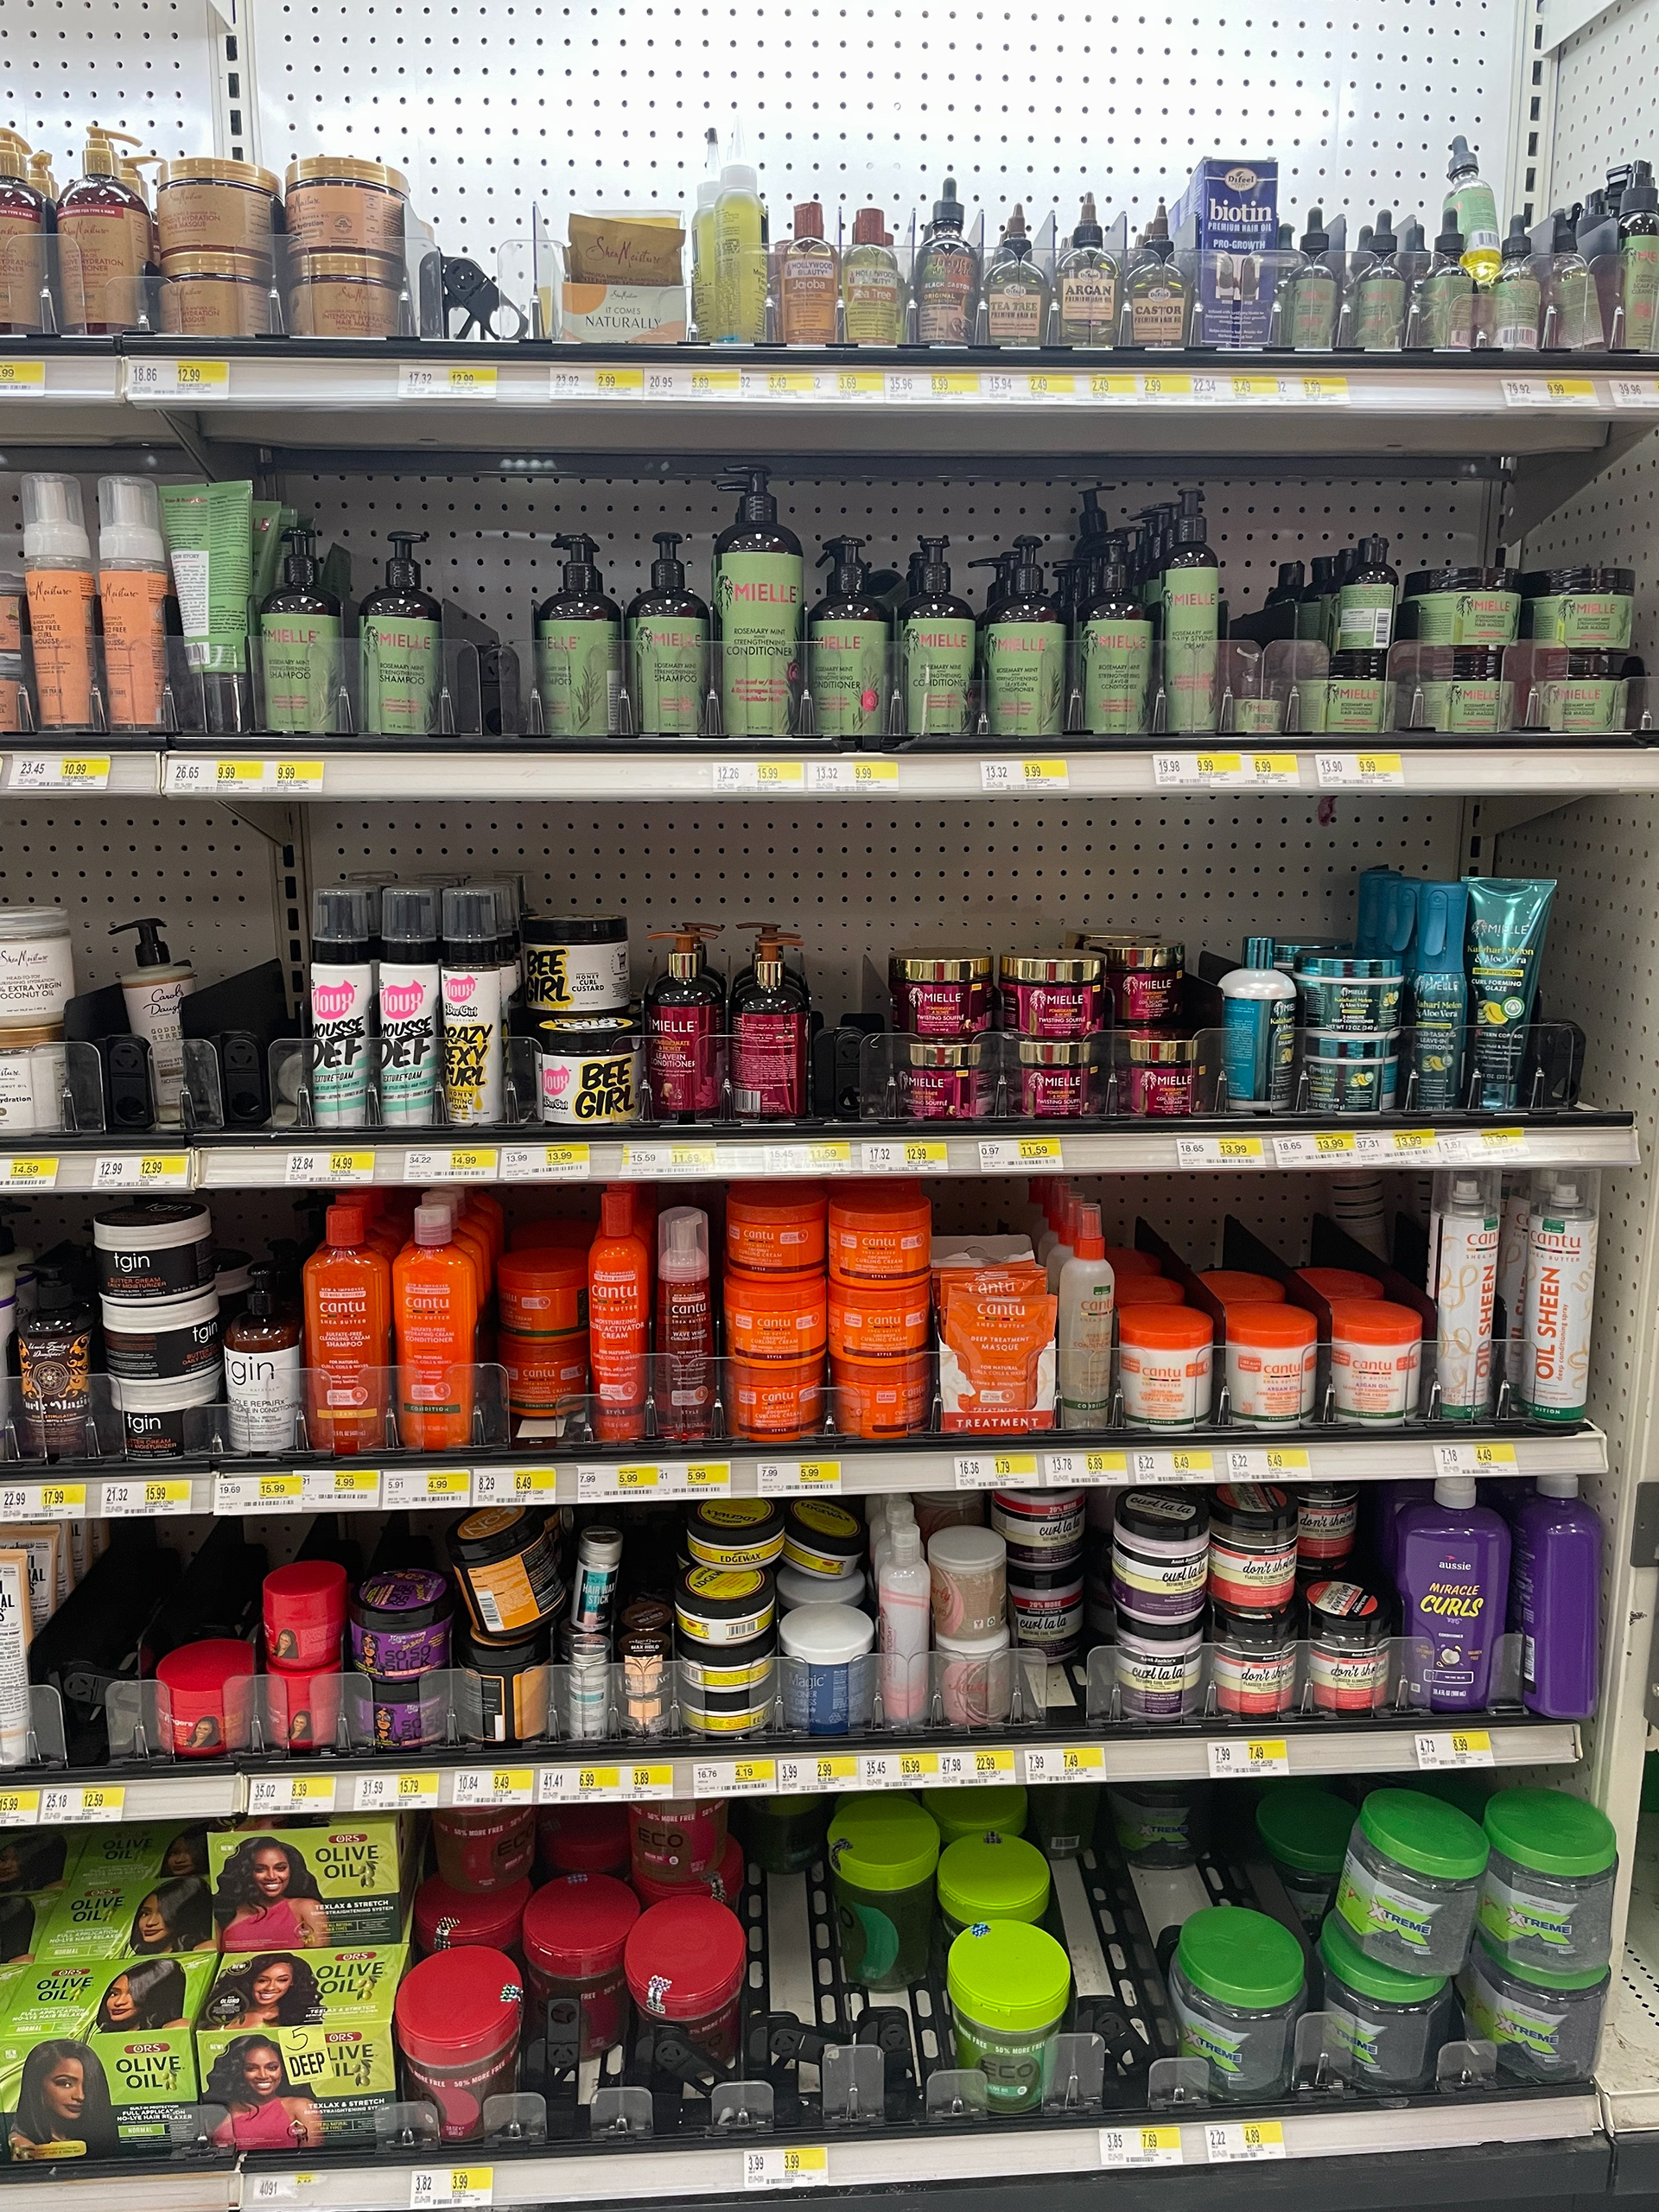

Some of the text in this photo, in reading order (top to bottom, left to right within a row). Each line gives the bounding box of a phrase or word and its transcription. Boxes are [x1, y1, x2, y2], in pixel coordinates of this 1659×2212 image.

[1228, 175, 1255, 185] Difeel
[1209, 200, 1273, 223] biotin
[1208, 222, 1273, 233] PREMIUM HAIR OIL
[1213, 239, 1267, 250] PRO-GROWTH
[1065, 284, 1112, 297] ARGAN
[991, 302, 1010, 313] TEA
[586, 316, 663, 330] NATURALLY
[133, 368, 158, 383] 18.86
[178, 369, 200, 383] 12.99
[556, 376, 580, 387] 23.92
[598, 376, 616, 388] 2.99
[650, 377, 674, 389] 20.95
[890, 378, 913, 391] 35.96
[931, 378, 950, 391] 8.99
[989, 378, 1013, 391] 15.94
[1507, 383, 1532, 396] 79.92
[734, 583, 797, 604] MIELLE
[1174, 593, 1216, 607] MIELLE
[1472, 600, 1511, 613] MIELLE
[270, 630, 315, 644] MIELLE
[379, 634, 431, 651] MIELLE
[920, 634, 968, 648] MIELLE
[726, 645, 793, 658] CONDITIONER
[270, 671, 311, 680] SHAMPOO
[379, 675, 425, 685] SHAMPOO
[1340, 689, 1379, 701] MIELLE
[21, 763, 46, 776] 23.45
[64, 763, 87, 776] 10.99
[1197, 760, 1214, 772] 9.99
[1322, 760, 1343, 773] 13.90
[1360, 761, 1376, 773] 9.99
[176, 767, 200, 779] 26.65
[277, 767, 296, 779] 9.99
[757, 768, 779, 780] 15.99
[817, 768, 838, 780] 13.32
[7, 981, 63, 994] EXTRA VIRGIN
[447, 979, 474, 1002] doux
[572, 984, 605, 993] CUSTARD
[925, 994, 962, 1003] MIELLE
[1047, 995, 1084, 1006] MIELLE
[652, 1020, 695, 1033] MIELLE
[582, 1058, 632, 1090] BEE
[1045, 1077, 1082, 1087] MIELLE
[575, 1090, 636, 1120] GIRL
[1021, 1146, 1048, 1156] 11.59
[1278, 1141, 1302, 1151] 18.65
[1318, 1139, 1344, 1151] 13.99
[1357, 1140, 1381, 1149] 37.31
[548, 1151, 573, 1161] 13.99
[982, 1147, 1000, 1156] 0.97
[292, 1157, 314, 1170] 32.84
[331, 1156, 353, 1170] 14.99
[409, 1156, 432, 1165] 34.22
[506, 1154, 528, 1163] 13.99
[100, 1162, 124, 1176] 12.99
[1531, 1231, 1582, 1250] cantu
[114, 1253, 150, 1273] tgin
[592, 1285, 639, 1300] cantu
[320, 1300, 367, 1313] cantu
[405, 1297, 450, 1310] cantu
[671, 1302, 707, 1315] cantu
[976, 1303, 1027, 1317] cantu
[1536, 1268, 1560, 1381] OIL SHEEN
[226, 1355, 275, 1385] tgin
[957, 1419, 1039, 1428] TREATMENT
[1173, 1454, 1190, 1468] 6.49
[1477, 1448, 1492, 1462] 4.49
[960, 1460, 980, 1475] 16.36
[1052, 1458, 1072, 1471] 13.78
[801, 1469, 820, 1478] 5.99
[335, 1478, 355, 1487] 4.99
[479, 1477, 495, 1491] 8.29
[516, 1477, 532, 1491] 6.49
[106, 1489, 129, 1502] 21.32
[146, 1488, 166, 1501] 15.99
[219, 1486, 241, 1495] 19.69
[4, 1494, 27, 1506] 22.99
[43, 1491, 65, 1504] 17.99
[721, 1552, 763, 1564] EDGEWAX
[1439, 1560, 1472, 1571] aussie
[582, 1583, 601, 1595] HAIR
[1430, 1583, 1480, 1596] MIRACLE
[588, 1593, 610, 1605] STICK
[1421, 1595, 1484, 1618] CURLS
[1452, 1738, 1468, 1751] 8.99
[976, 1758, 995, 1770] 22.99
[1064, 1755, 1078, 1768] 7.49
[634, 1771, 650, 1785] 3.89
[735, 1768, 754, 1777] 4.19
[400, 1780, 419, 1794] 15.79
[543, 1774, 564, 1788] 41.41
[255, 1784, 276, 1798] 35.02
[47, 1794, 67, 1808] 25.18
[335, 1834, 361, 1844] ORS
[638, 1827, 684, 1850] ECO
[315, 1846, 378, 1863] OLIVE
[324, 1864, 360, 1879] OIL
[317, 1962, 385, 1979] OLIVE
[37, 1977, 94, 1991] OLIVE
[321, 1978, 358, 1993] OIL
[38, 1990, 71, 2002] OIL
[285, 2028, 309, 2051] 5
[329, 2033, 355, 2042] ORS
[132, 2044, 162, 2054] ORS
[328, 2044, 374, 2061] LIVE
[116, 2057, 181, 2075] OLIVE
[289, 2053, 326, 2076] DEEP
[126, 2074, 163, 2090] OIL
[351, 2099, 385, 2107] STRETCH
[1142, 2134, 1158, 2148] 7.69
[1244, 2130, 1261, 2144] 4.89
[748, 2156, 765, 2171] 3.99
[416, 2177, 432, 2191] 3.82
